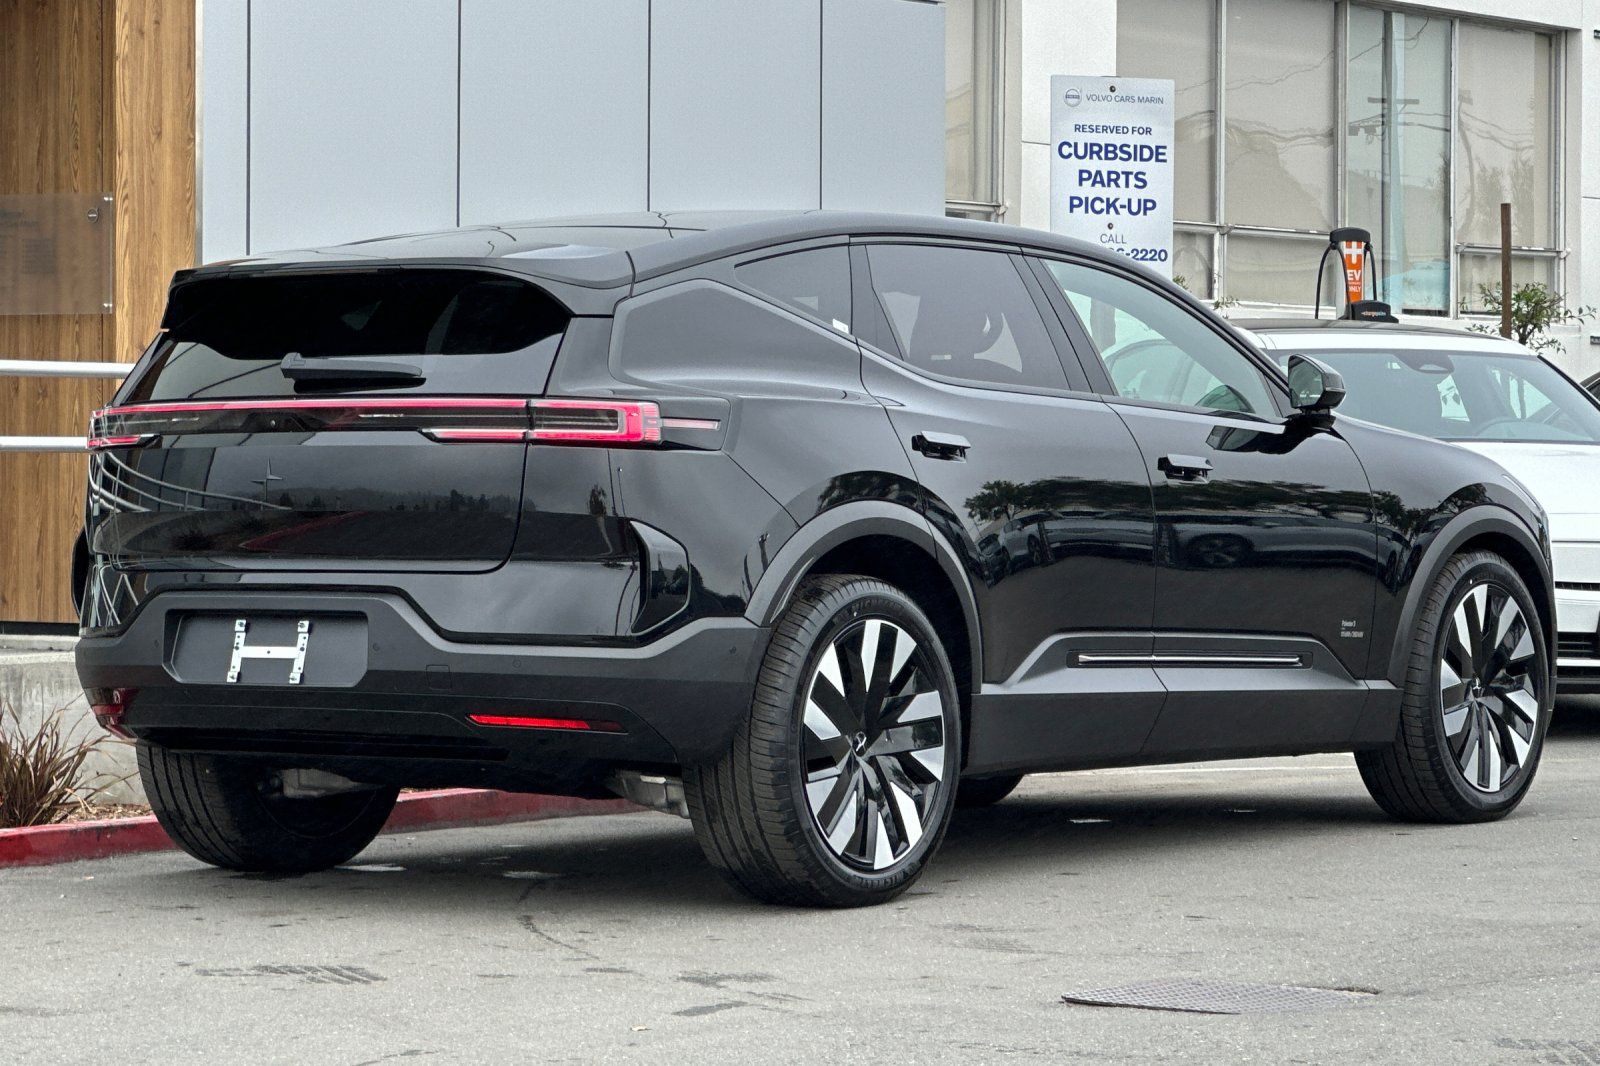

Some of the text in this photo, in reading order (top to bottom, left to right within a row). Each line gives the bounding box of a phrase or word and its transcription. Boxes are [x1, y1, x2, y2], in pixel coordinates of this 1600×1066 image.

[1086, 94, 1112, 103] VOLVO
[1114, 95, 1136, 104] CARS
[1138, 96, 1164, 105] MARIN
[1074, 124, 1152, 136] RESERVED FOR
[1058, 141, 1168, 163] CURBSIDE
[1078, 169, 1148, 189] PARTS
[1069, 196, 1157, 216] PICK-UP
[1100, 233, 1127, 244] CALL
[1109, 247, 1168, 262] -2220
[1347, 270, 1361, 281] EV
[1348, 285, 1361, 293] NLY
